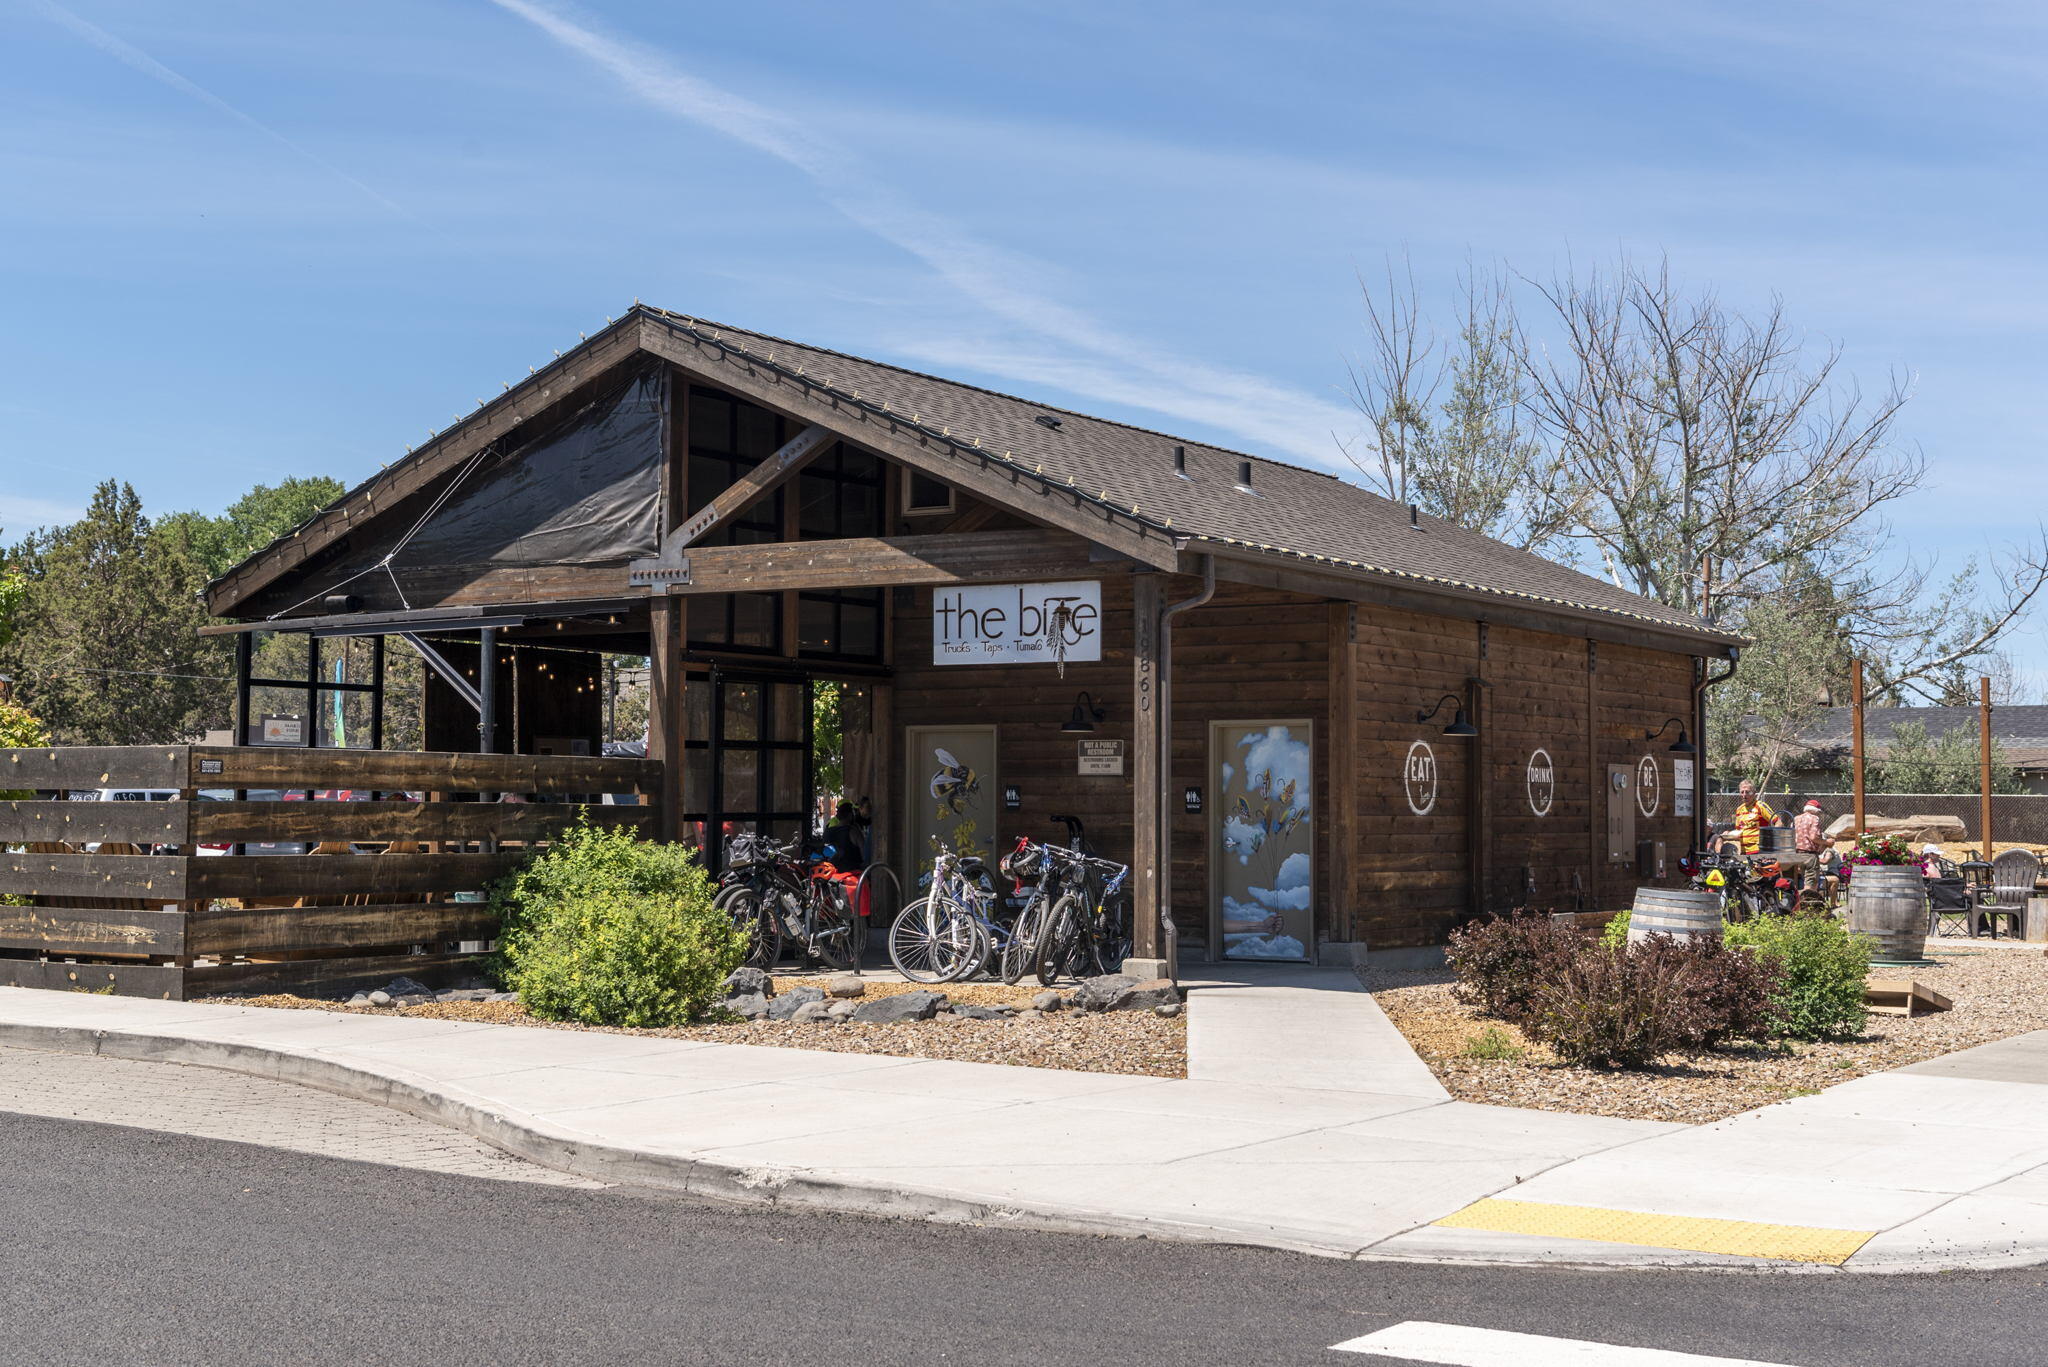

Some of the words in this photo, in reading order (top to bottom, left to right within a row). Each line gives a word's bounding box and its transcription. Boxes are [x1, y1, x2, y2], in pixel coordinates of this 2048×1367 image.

[935, 592, 1007, 640] the
[1018, 588, 1098, 646] bite
[941, 641, 971, 654] Trucks
[980, 640, 1003, 657] Taps
[1013, 639, 1043, 652] Tumalo
[1084, 741, 1094, 749] NOT
[1100, 741, 1118, 749] PUBLIC
[1411, 756, 1431, 782] EAT
[1530, 767, 1551, 783] DRINK
[1643, 766, 1653, 787] BE
